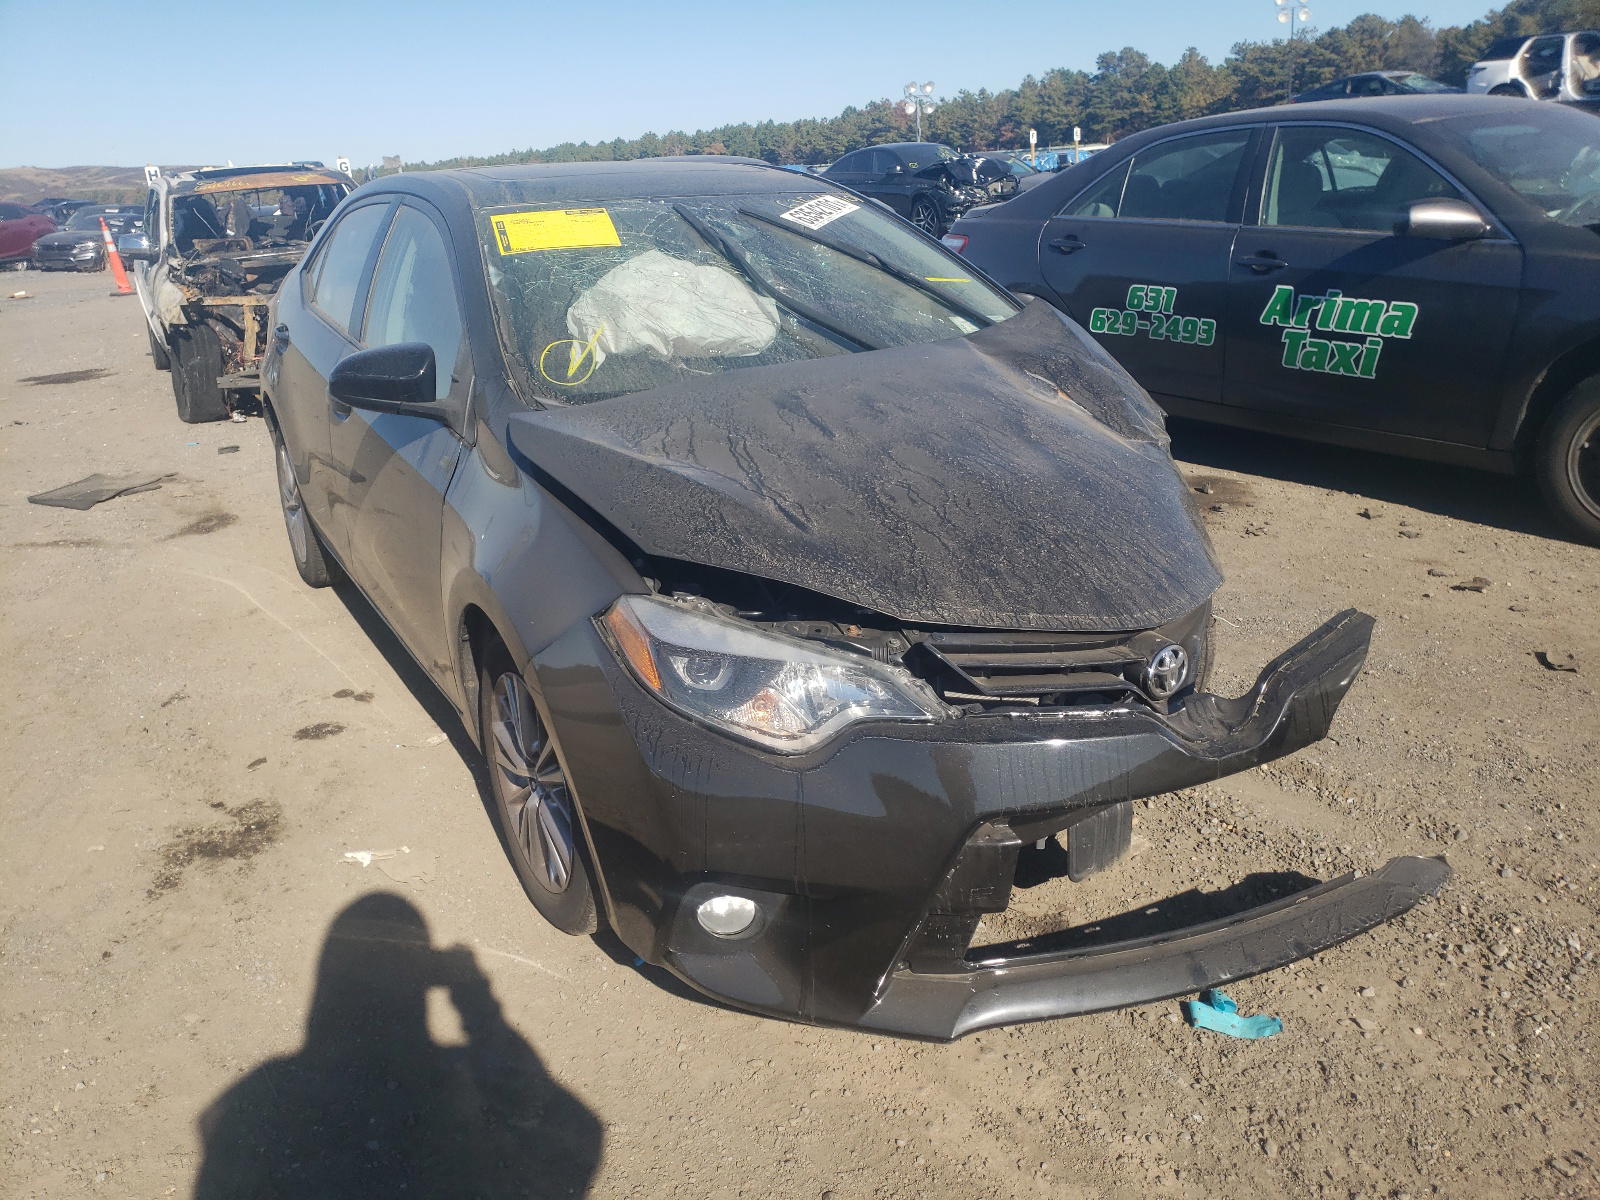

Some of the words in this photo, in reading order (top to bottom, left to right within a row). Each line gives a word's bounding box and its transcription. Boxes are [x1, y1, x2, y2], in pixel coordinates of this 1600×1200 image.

[147, 170, 158, 182] H
[339, 161, 349, 172] G
[1126, 284, 1177, 314] 631
[1260, 284, 1418, 339] Arima
[1090, 307, 1216, 346] 629-2493
[1282, 329, 1383, 379] Taxi
